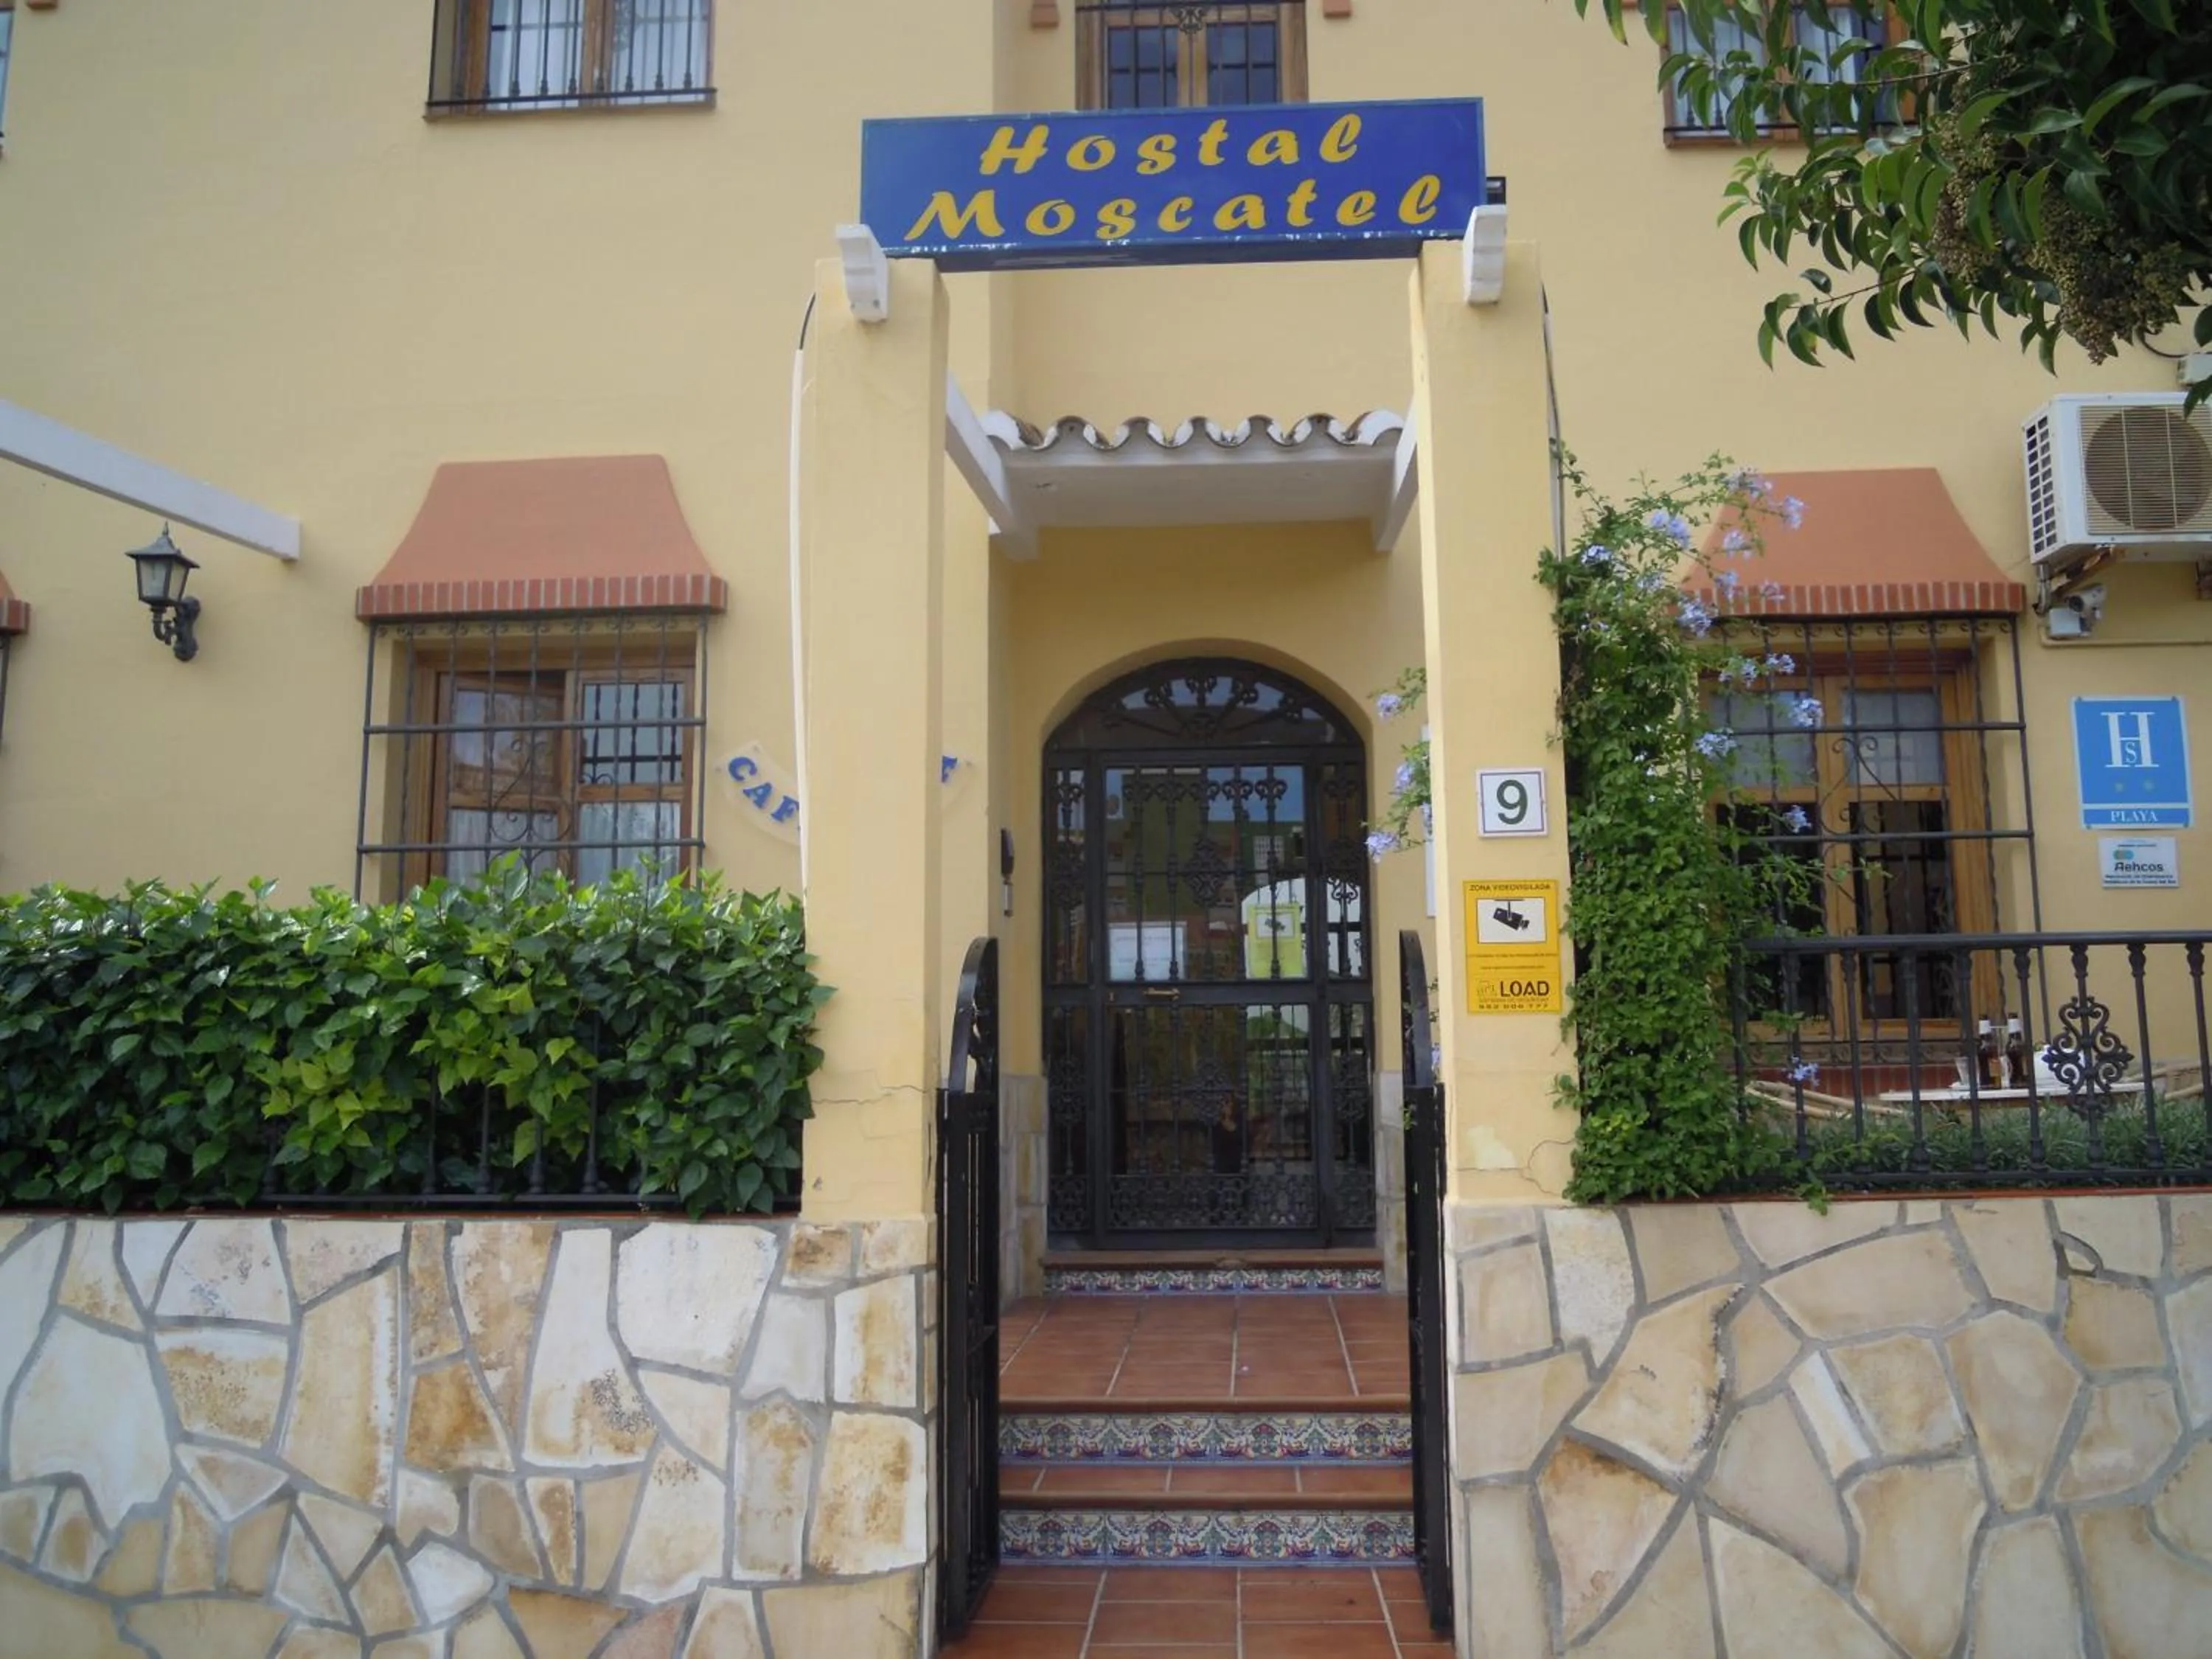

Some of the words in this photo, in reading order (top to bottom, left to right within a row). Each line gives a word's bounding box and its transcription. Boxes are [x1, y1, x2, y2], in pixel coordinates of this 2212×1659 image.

[979, 113, 1362, 175] Hostal
[904, 175, 1441, 240] Moscatel
[1497, 779, 1528, 824] 9
[2111, 810, 2158, 823] PLAYA
[2115, 861, 2164, 872] Aehcos
[1500, 981, 1550, 997] LOAD
